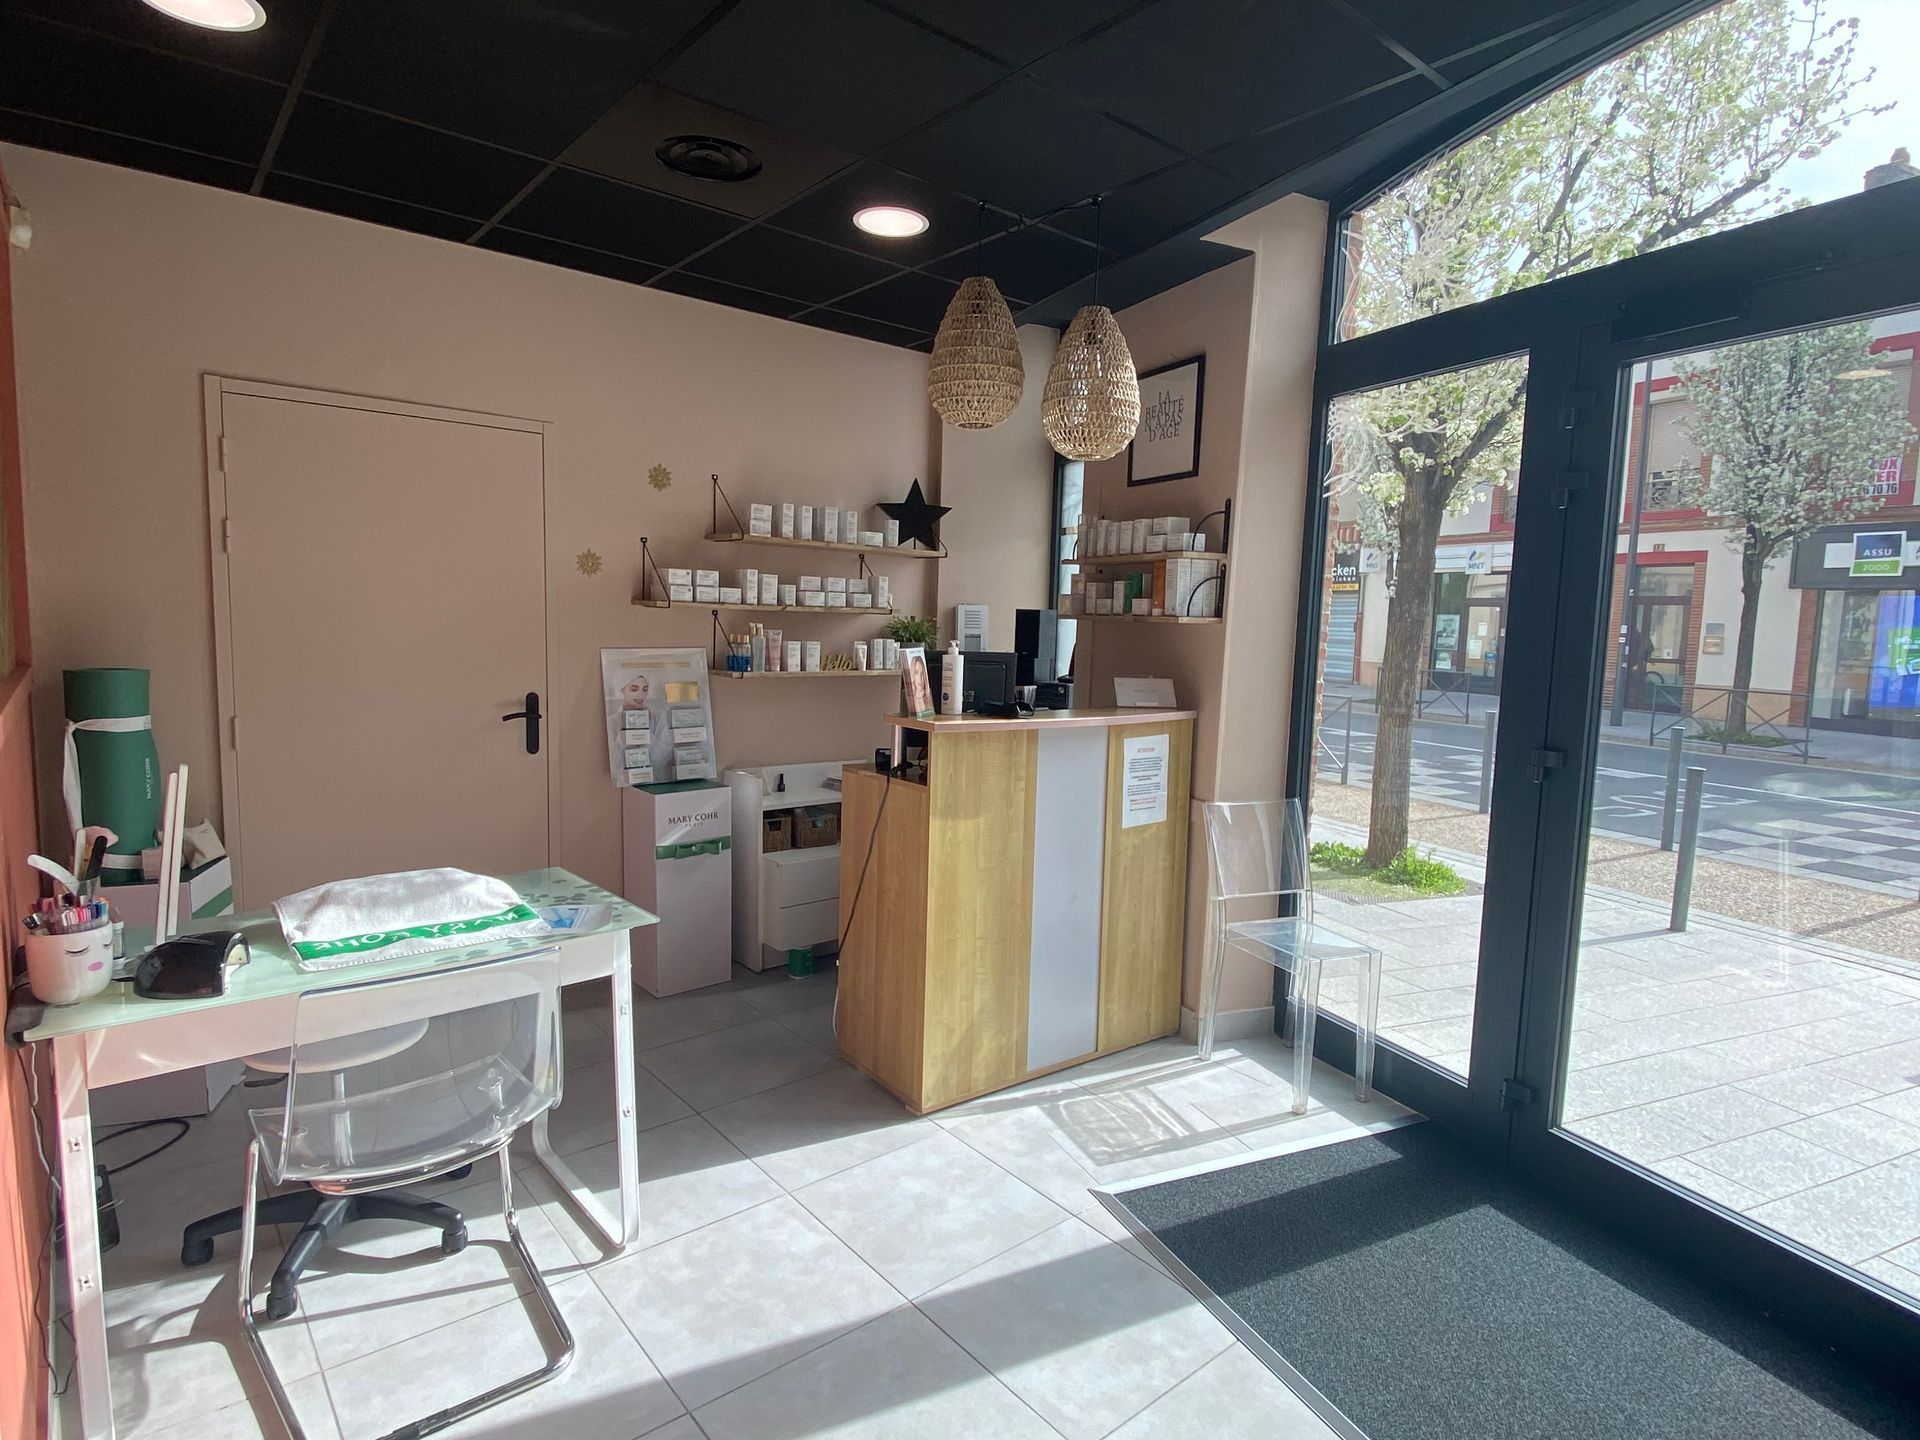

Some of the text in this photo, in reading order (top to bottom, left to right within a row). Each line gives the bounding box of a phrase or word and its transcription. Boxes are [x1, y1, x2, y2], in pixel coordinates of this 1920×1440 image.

[1159, 390, 1171, 404] LA
[1871, 484, 1883, 495] 70
[1887, 483, 1898, 494] 76
[1863, 548, 1893, 556] ASSU
[667, 811, 719, 825] MARY COHR
